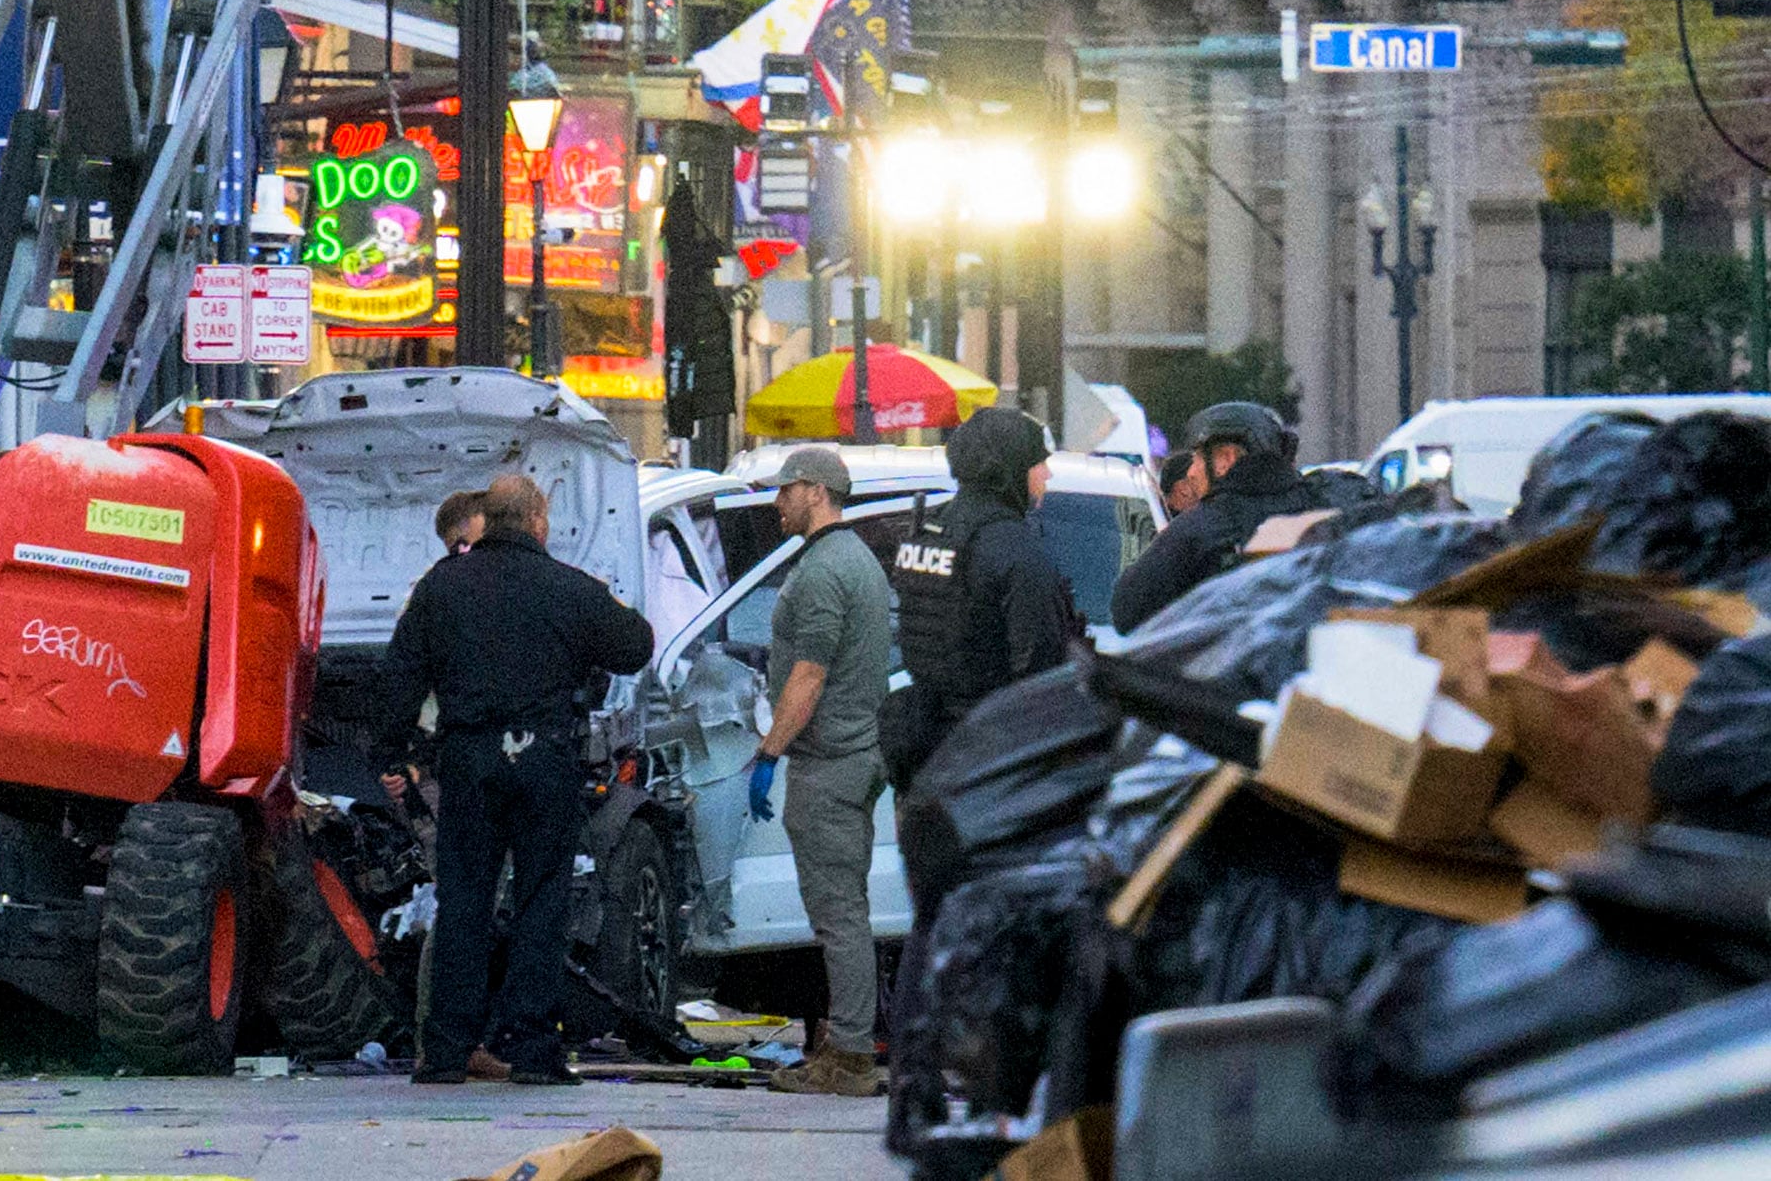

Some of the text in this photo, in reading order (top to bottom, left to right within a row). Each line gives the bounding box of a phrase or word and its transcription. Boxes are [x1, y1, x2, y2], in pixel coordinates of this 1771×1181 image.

[1349, 26, 1435, 69] Canal
[201, 301, 228, 317] CAB
[273, 301, 288, 312] TO
[255, 315, 304, 327] CORNER
[193, 322, 237, 338] STAND
[253, 344, 306, 358] ANYTIME
[89, 500, 181, 534] 10507501
[18, 548, 186, 584] www.unitedrentals.com
